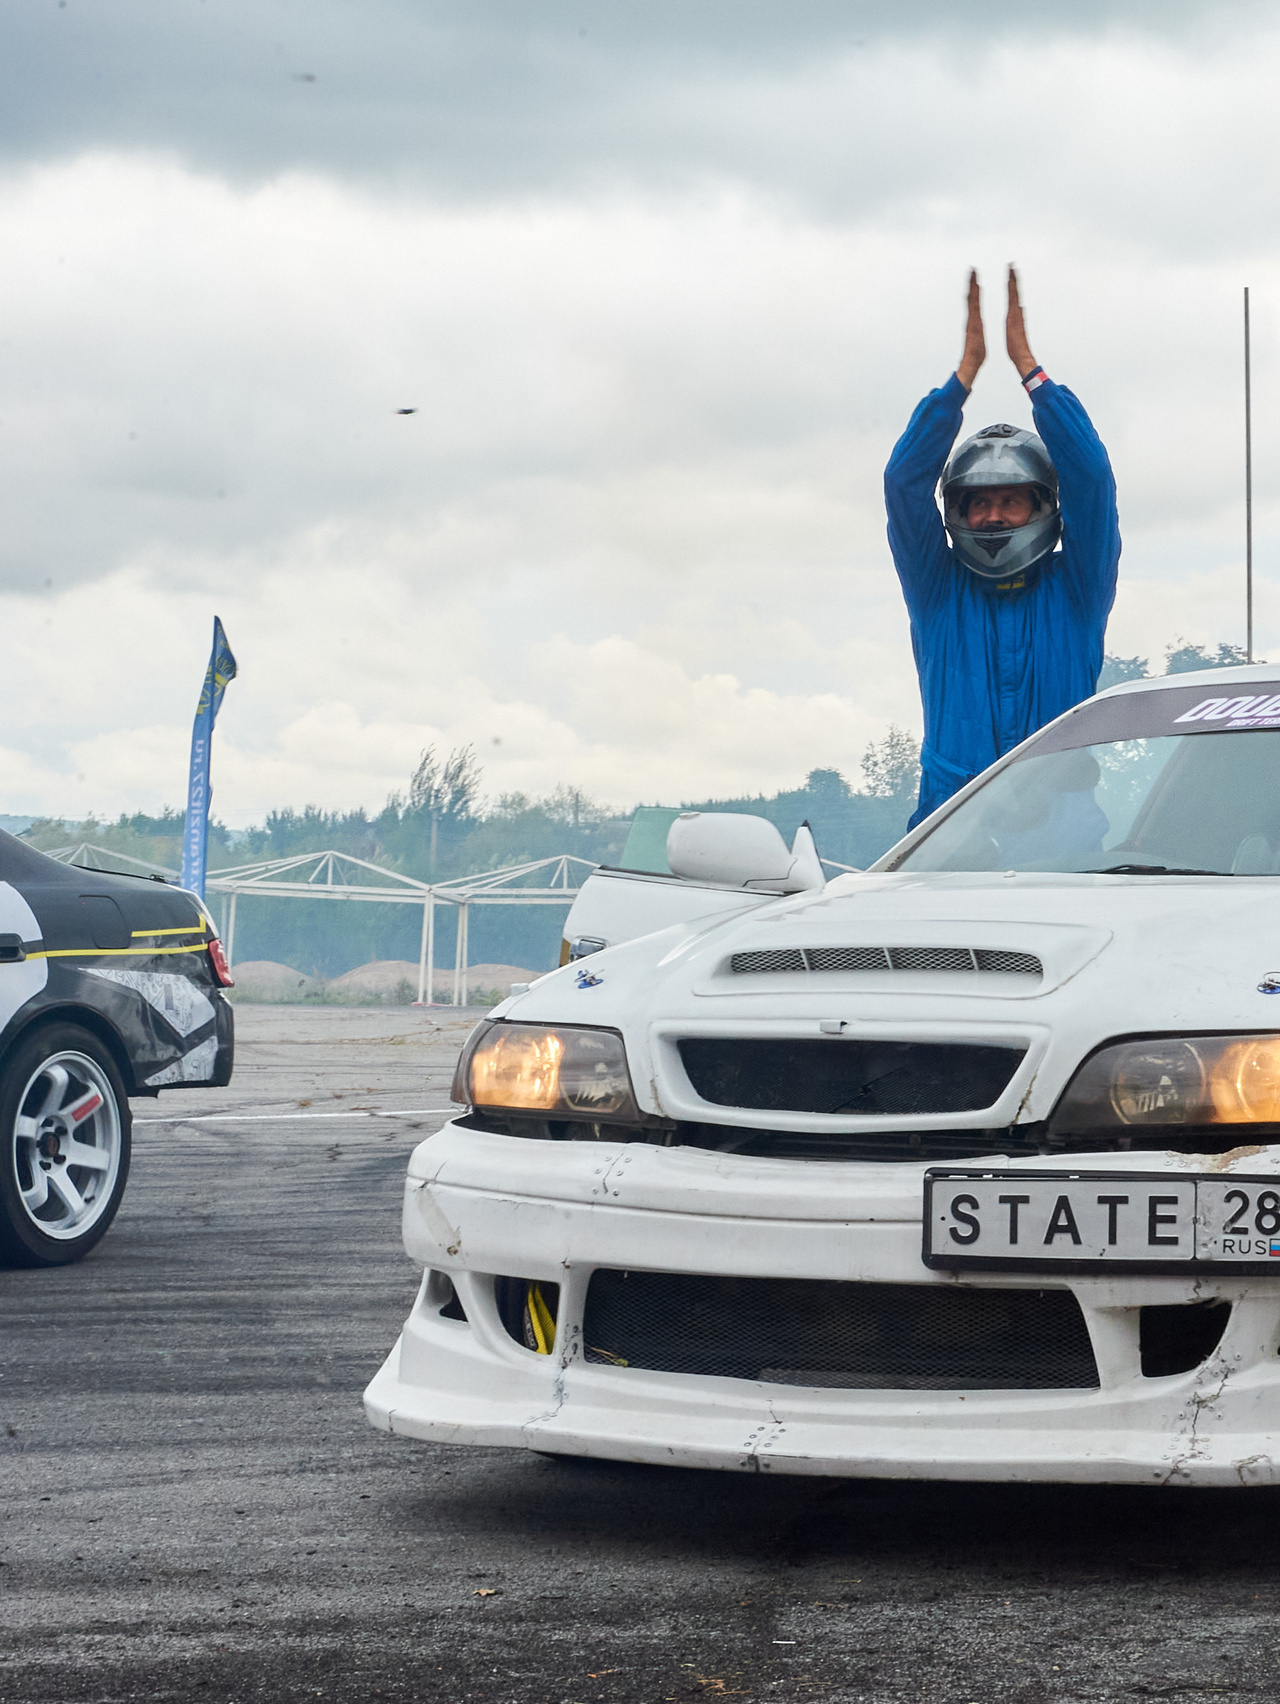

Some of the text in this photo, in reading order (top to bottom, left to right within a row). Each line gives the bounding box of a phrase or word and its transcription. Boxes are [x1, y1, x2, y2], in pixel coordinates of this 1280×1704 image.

[1227, 718, 1258, 727] DRIFT
[949, 1194, 1179, 1245] STATE
[1222, 1239, 1267, 1255] RUS
